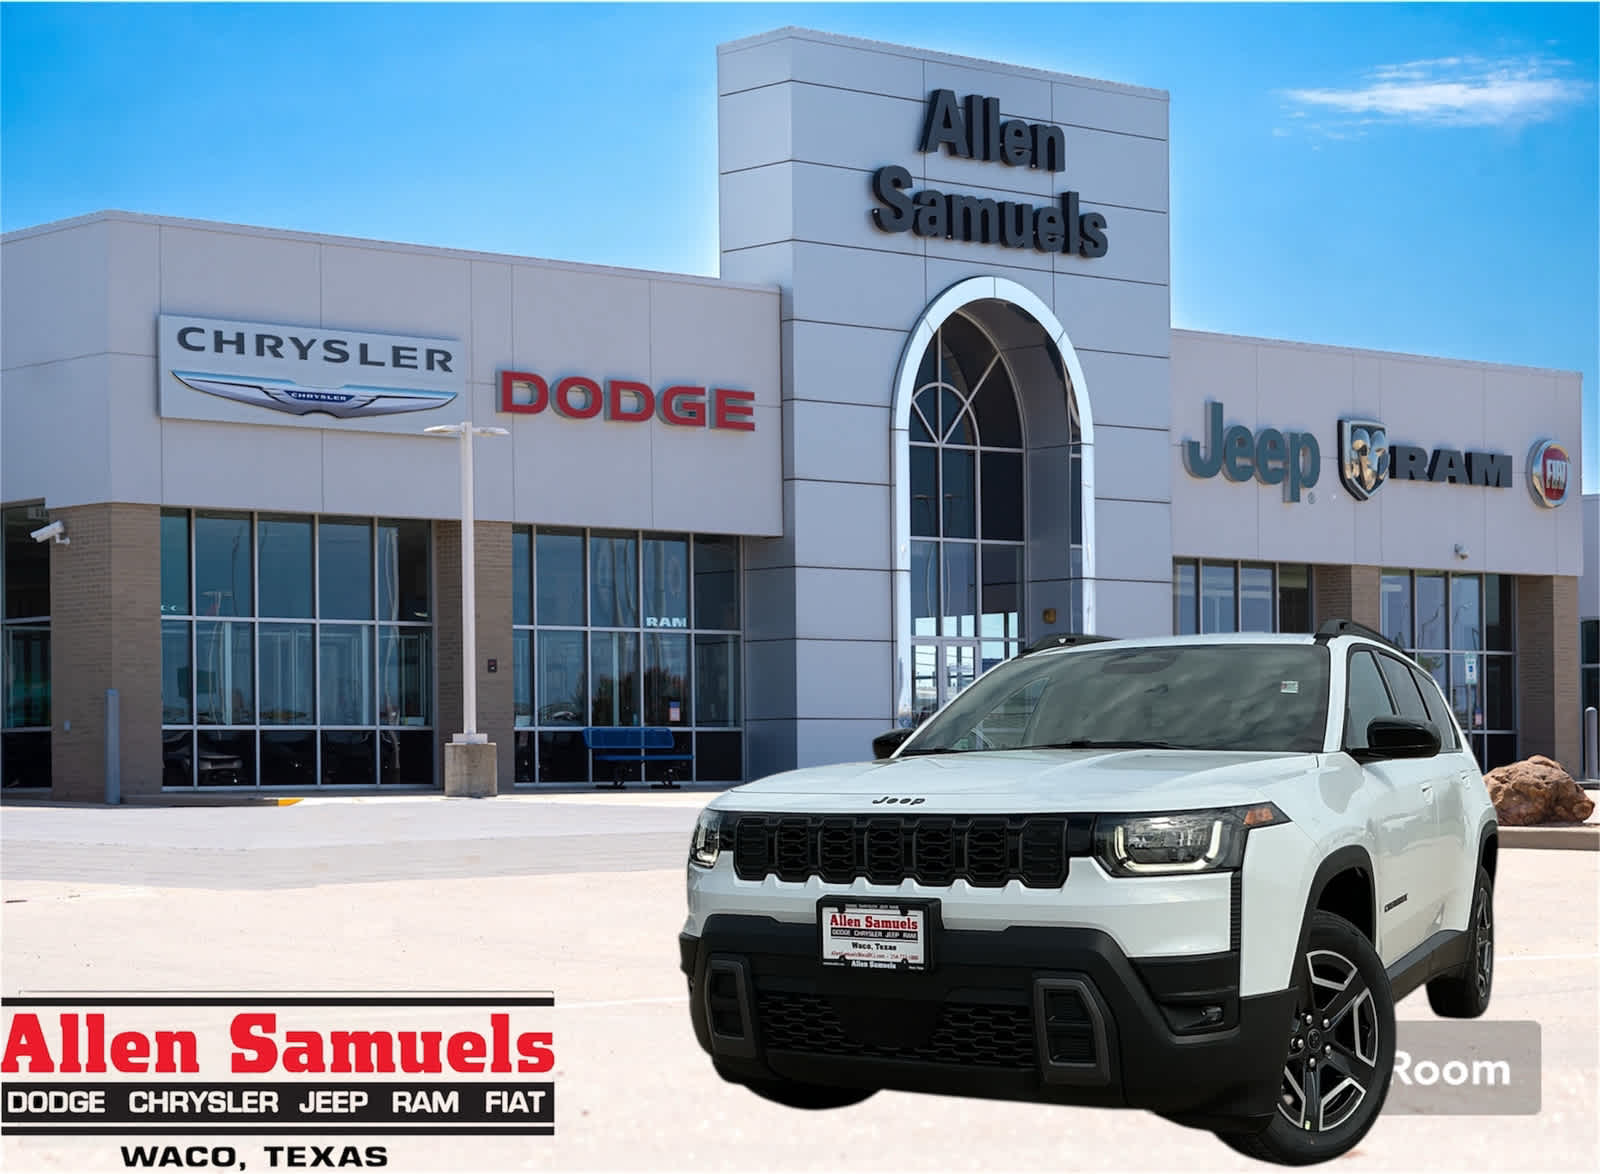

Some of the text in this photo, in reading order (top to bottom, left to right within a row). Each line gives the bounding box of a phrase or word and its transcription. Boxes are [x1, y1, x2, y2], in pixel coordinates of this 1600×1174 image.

[918, 88, 1067, 173] Allen
[871, 165, 1109, 258] Samuels
[176, 326, 454, 373] CHRYSLER
[290, 392, 347, 401] CHRYSLER
[496, 370, 756, 432] DODGE
[1182, 400, 1321, 503] Jeep
[1388, 445, 1513, 488] RAM
[646, 616, 687, 628] RAM
[872, 796, 926, 805] Jeep
[830, 914, 918, 930] Allen Samuels
[854, 930, 883, 938] CHRYSLER
[851, 942, 897, 951] Waco, Texas
[851, 960, 869, 968] Allen
